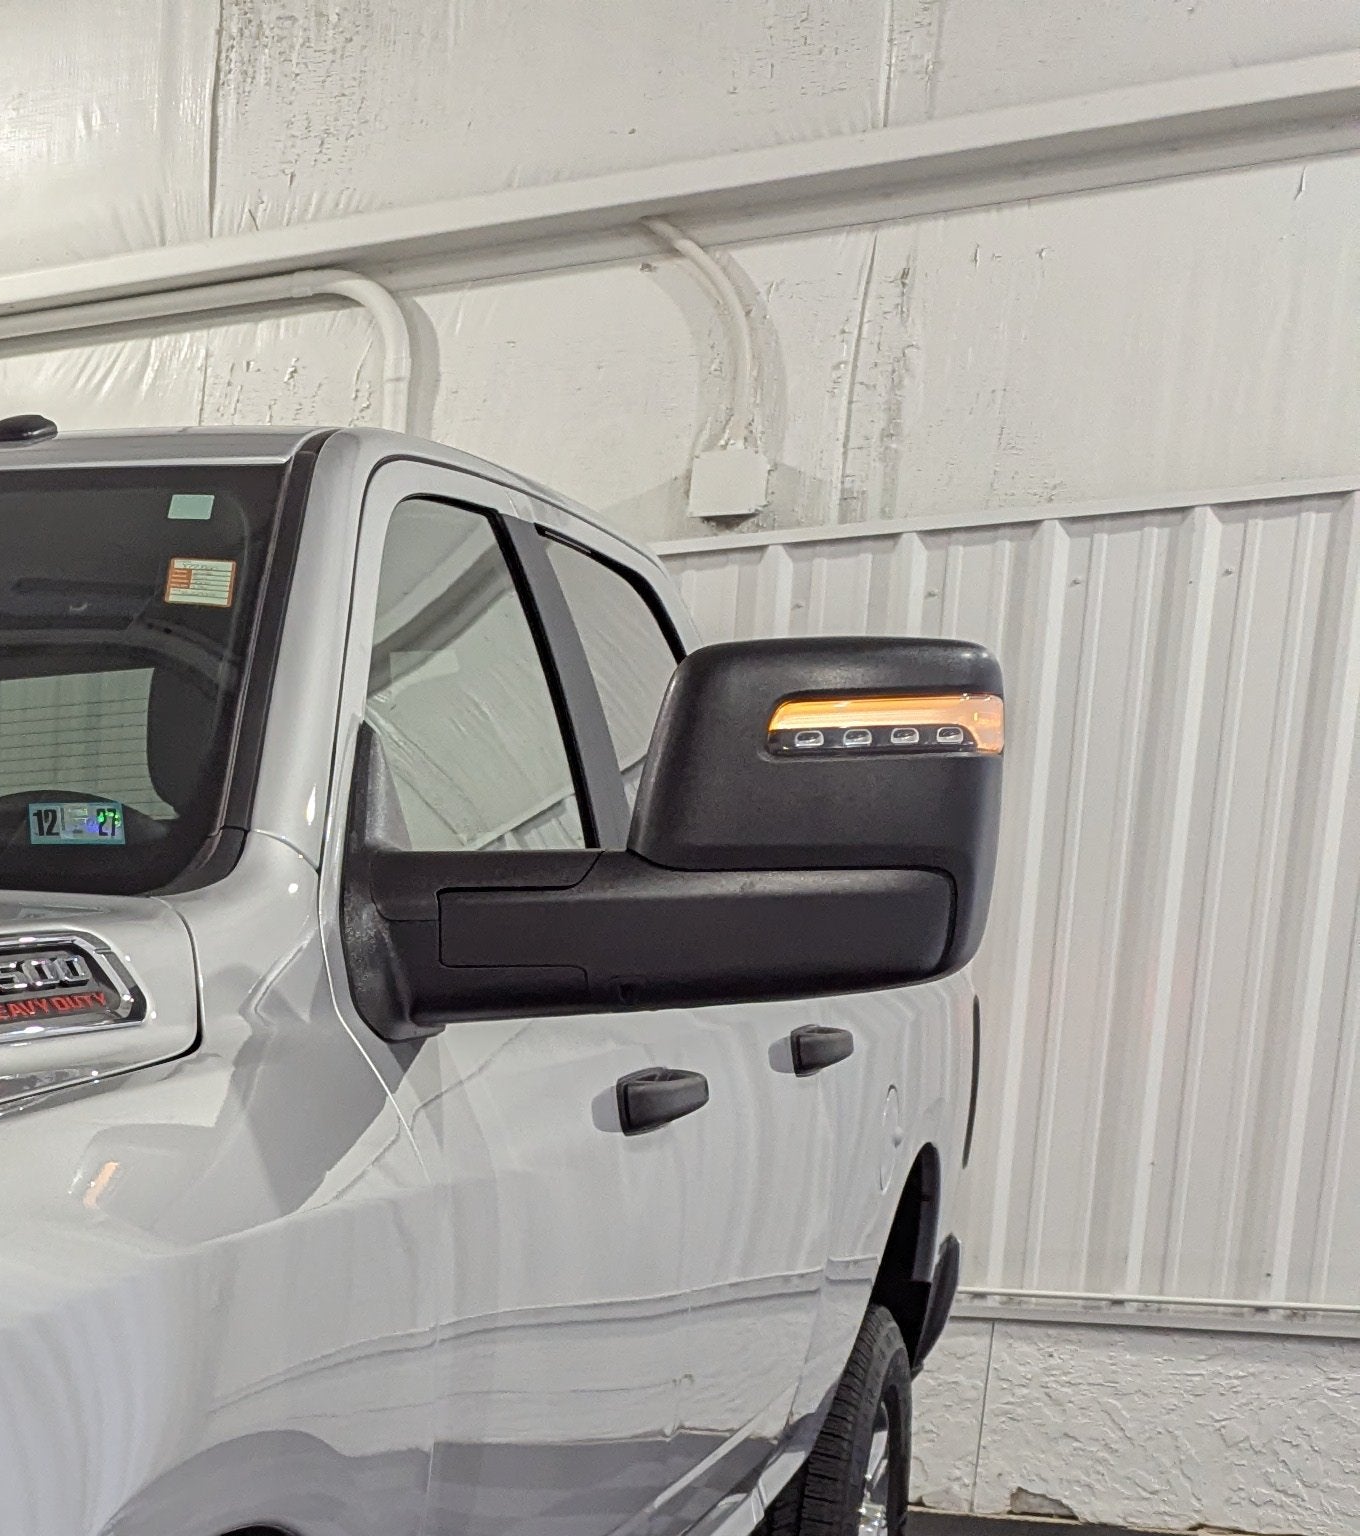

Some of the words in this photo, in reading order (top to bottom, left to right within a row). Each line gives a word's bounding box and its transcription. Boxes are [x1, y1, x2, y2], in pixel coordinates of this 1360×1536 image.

[32, 808, 60, 837] 12
[96, 807, 118, 837] 27
[53, 991, 107, 1013] DUTY
